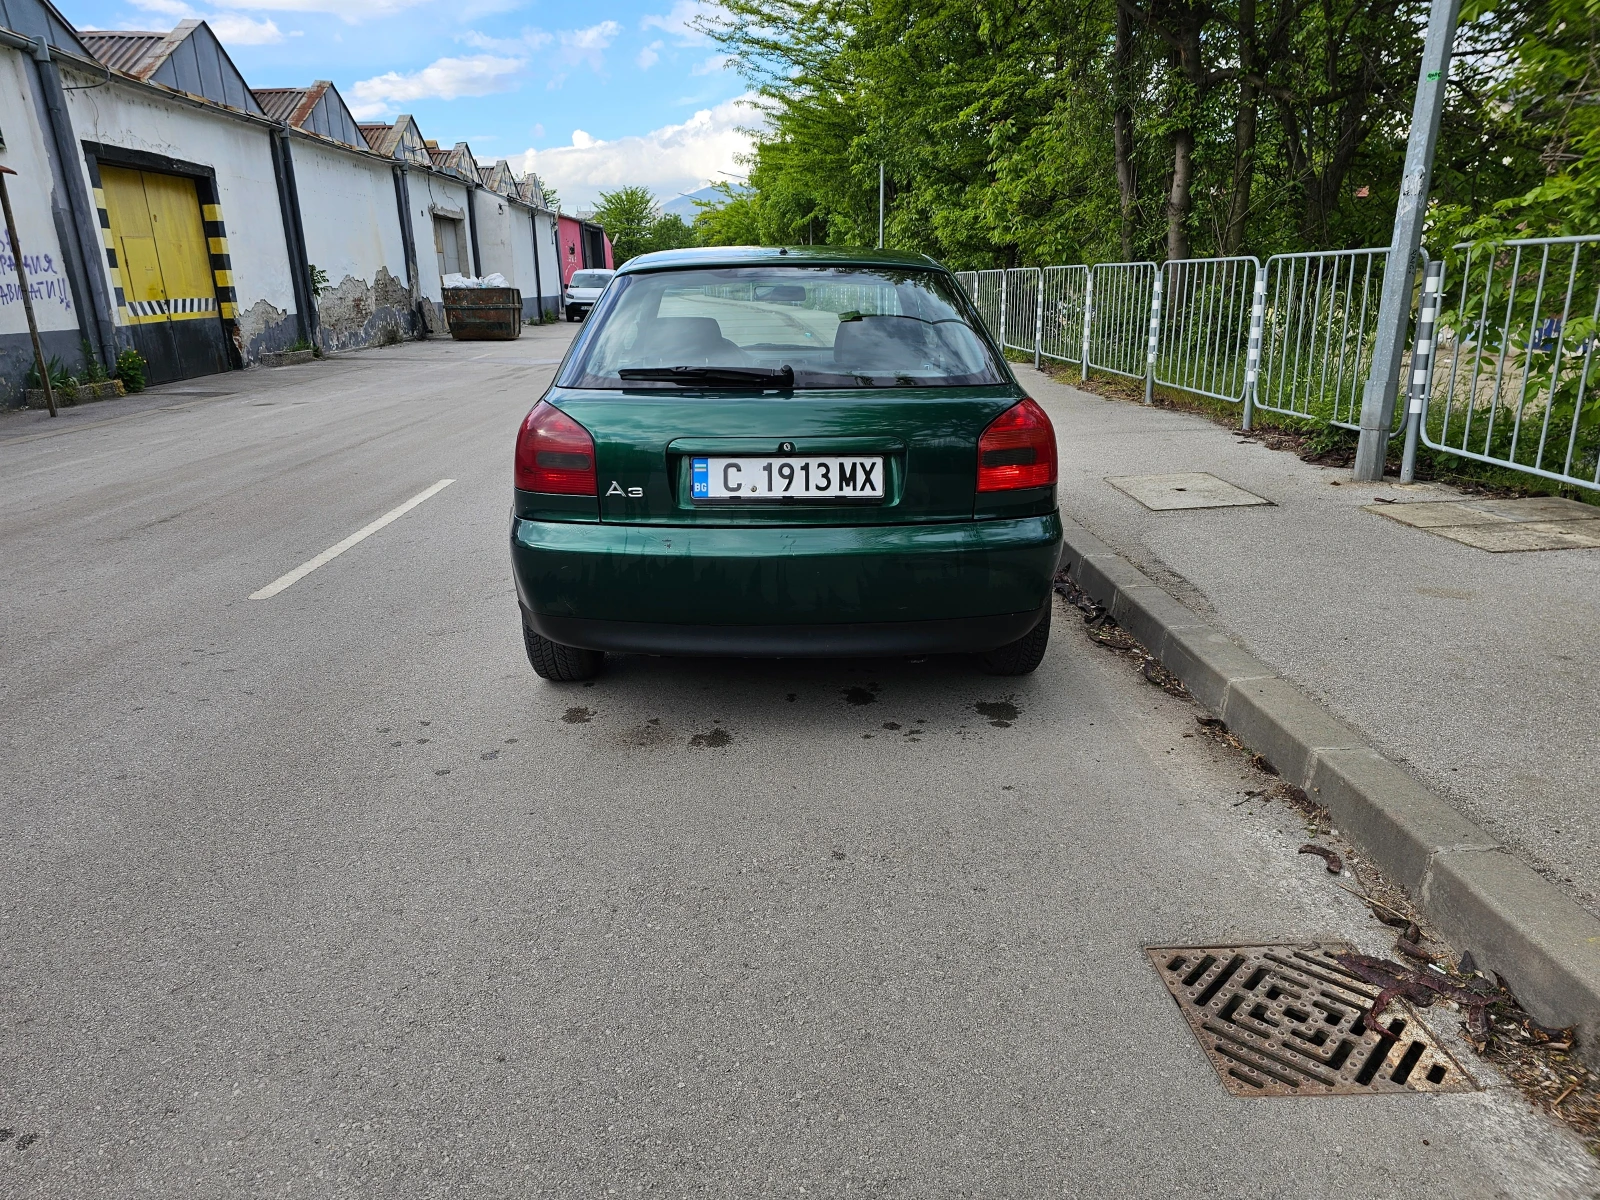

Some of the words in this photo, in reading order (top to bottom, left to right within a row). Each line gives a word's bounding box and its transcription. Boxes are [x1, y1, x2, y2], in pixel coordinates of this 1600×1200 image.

[723, 462, 742, 492] C
[763, 462, 831, 492] 1913
[838, 462, 877, 491] MX
[605, 480, 644, 498] A3
[694, 482, 707, 492] BG
